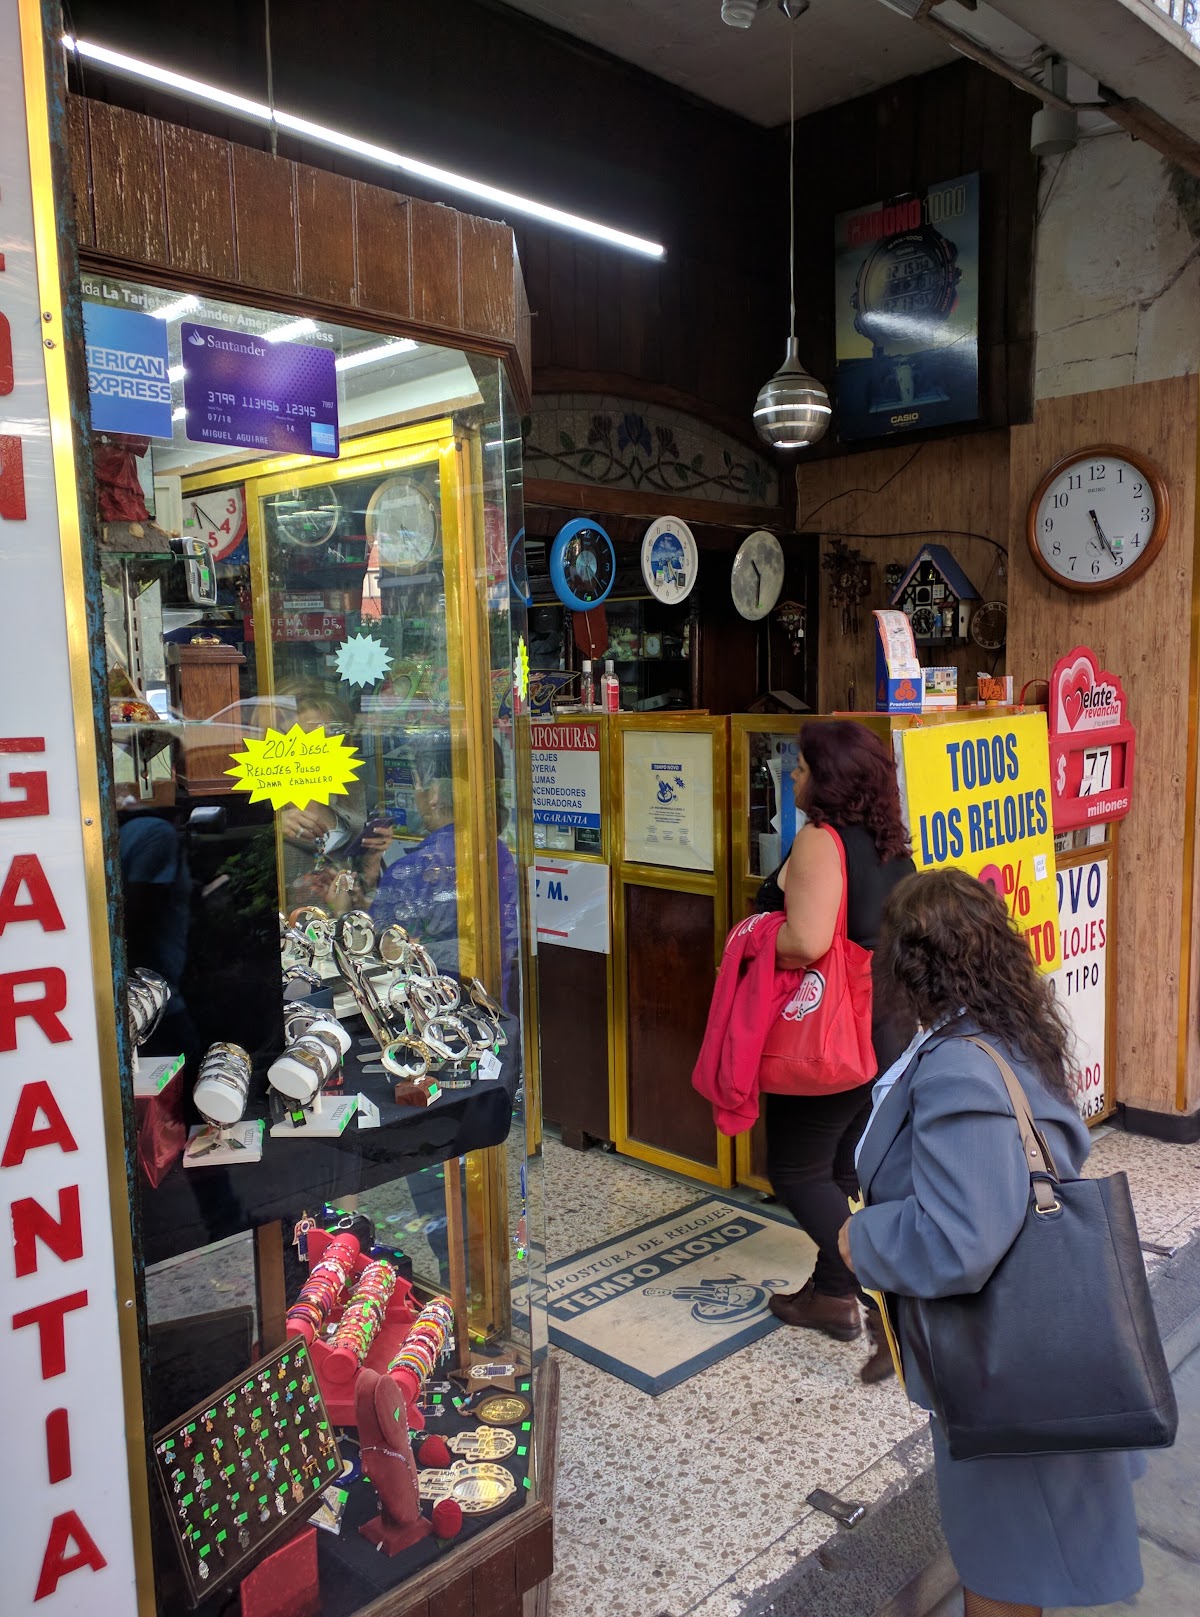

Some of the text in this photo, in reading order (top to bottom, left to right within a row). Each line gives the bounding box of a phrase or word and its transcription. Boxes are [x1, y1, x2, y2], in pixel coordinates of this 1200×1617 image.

[923, 185, 966, 226] 1000
[103, 284, 119, 300] La
[207, 334, 266, 357] Santander
[87, 347, 164, 378] ERICAN
[207, 391, 236, 406] 3799
[241, 396, 280, 412] 113456
[285, 402, 316, 418] 12345
[207, 413, 232, 424] 07/18
[891, 412, 919, 424] CASIO
[202, 428, 269, 445] MIGUEL AGUIRRE
[286, 424, 295, 432] 14
[1088, 464, 1106, 481] 12
[1117, 468, 1124, 484] 1
[1068, 474, 1082, 490] 11
[1133, 482, 1143, 499] 2
[226, 498, 236, 514] 3
[1053, 492, 1069, 509] 10
[1140, 506, 1150, 523] 3
[220, 517, 231, 535] 4
[1045, 517, 1054, 533] 9
[207, 531, 218, 549] 5
[1052, 541, 1061, 556] 8
[1131, 533, 1141, 548] 4
[605, 562, 610, 571] 3
[1068, 556, 1077, 571] 7
[1091, 559, 1100, 575] 6
[1114, 551, 1124, 567] 5
[249, 618, 338, 627] STEMA DE
[1084, 702, 1119, 719] revancha
[262, 736, 330, 760] 20% DESC.
[245, 762, 292, 777] RELOJES
[946, 732, 1019, 792] TODOS
[257, 775, 333, 789] DAMA CABALLERO
[1056, 750, 1109, 797] $ 77
[1087, 798, 1128, 818] millones
[543, 812, 588, 825] GARANTIA
[919, 788, 1048, 866] LOS RELOJES
[547, 880, 569, 902] M.
[1066, 962, 1099, 996] TIPO
[640, 1236, 664, 1252] DE
[664, 1204, 736, 1242] RELOJES
[552, 1224, 748, 1314] TEMPO NOVO
